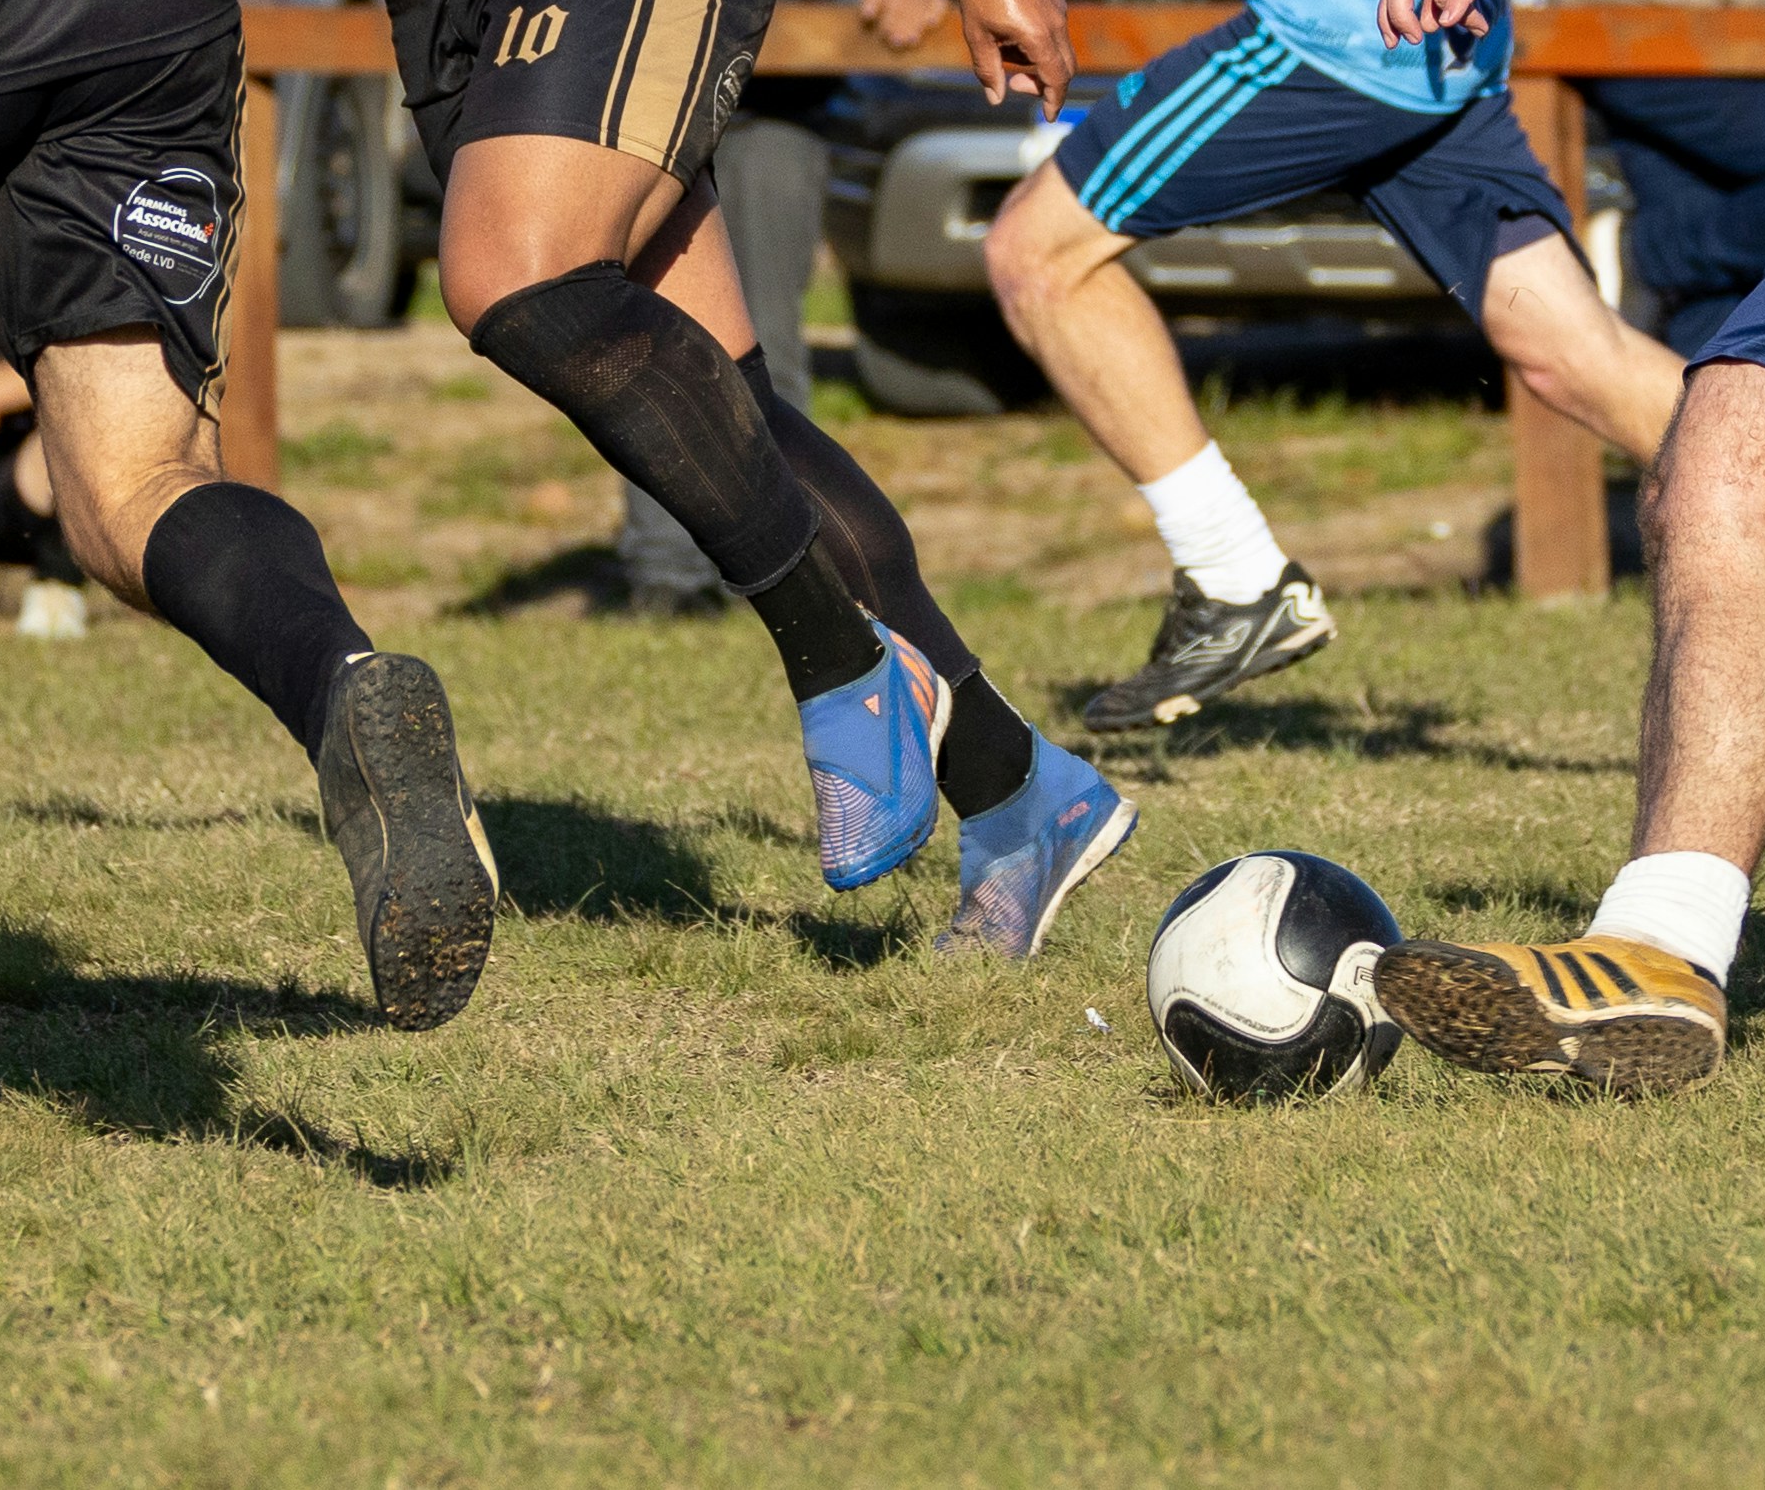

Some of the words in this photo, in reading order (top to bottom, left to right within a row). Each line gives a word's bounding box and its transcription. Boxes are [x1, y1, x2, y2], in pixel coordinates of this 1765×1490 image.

[494, 4, 570, 68] 10
[133, 196, 188, 217] FARMÁCIAS
[122, 243, 151, 262] Rede
[152, 254, 175, 269] LVD
